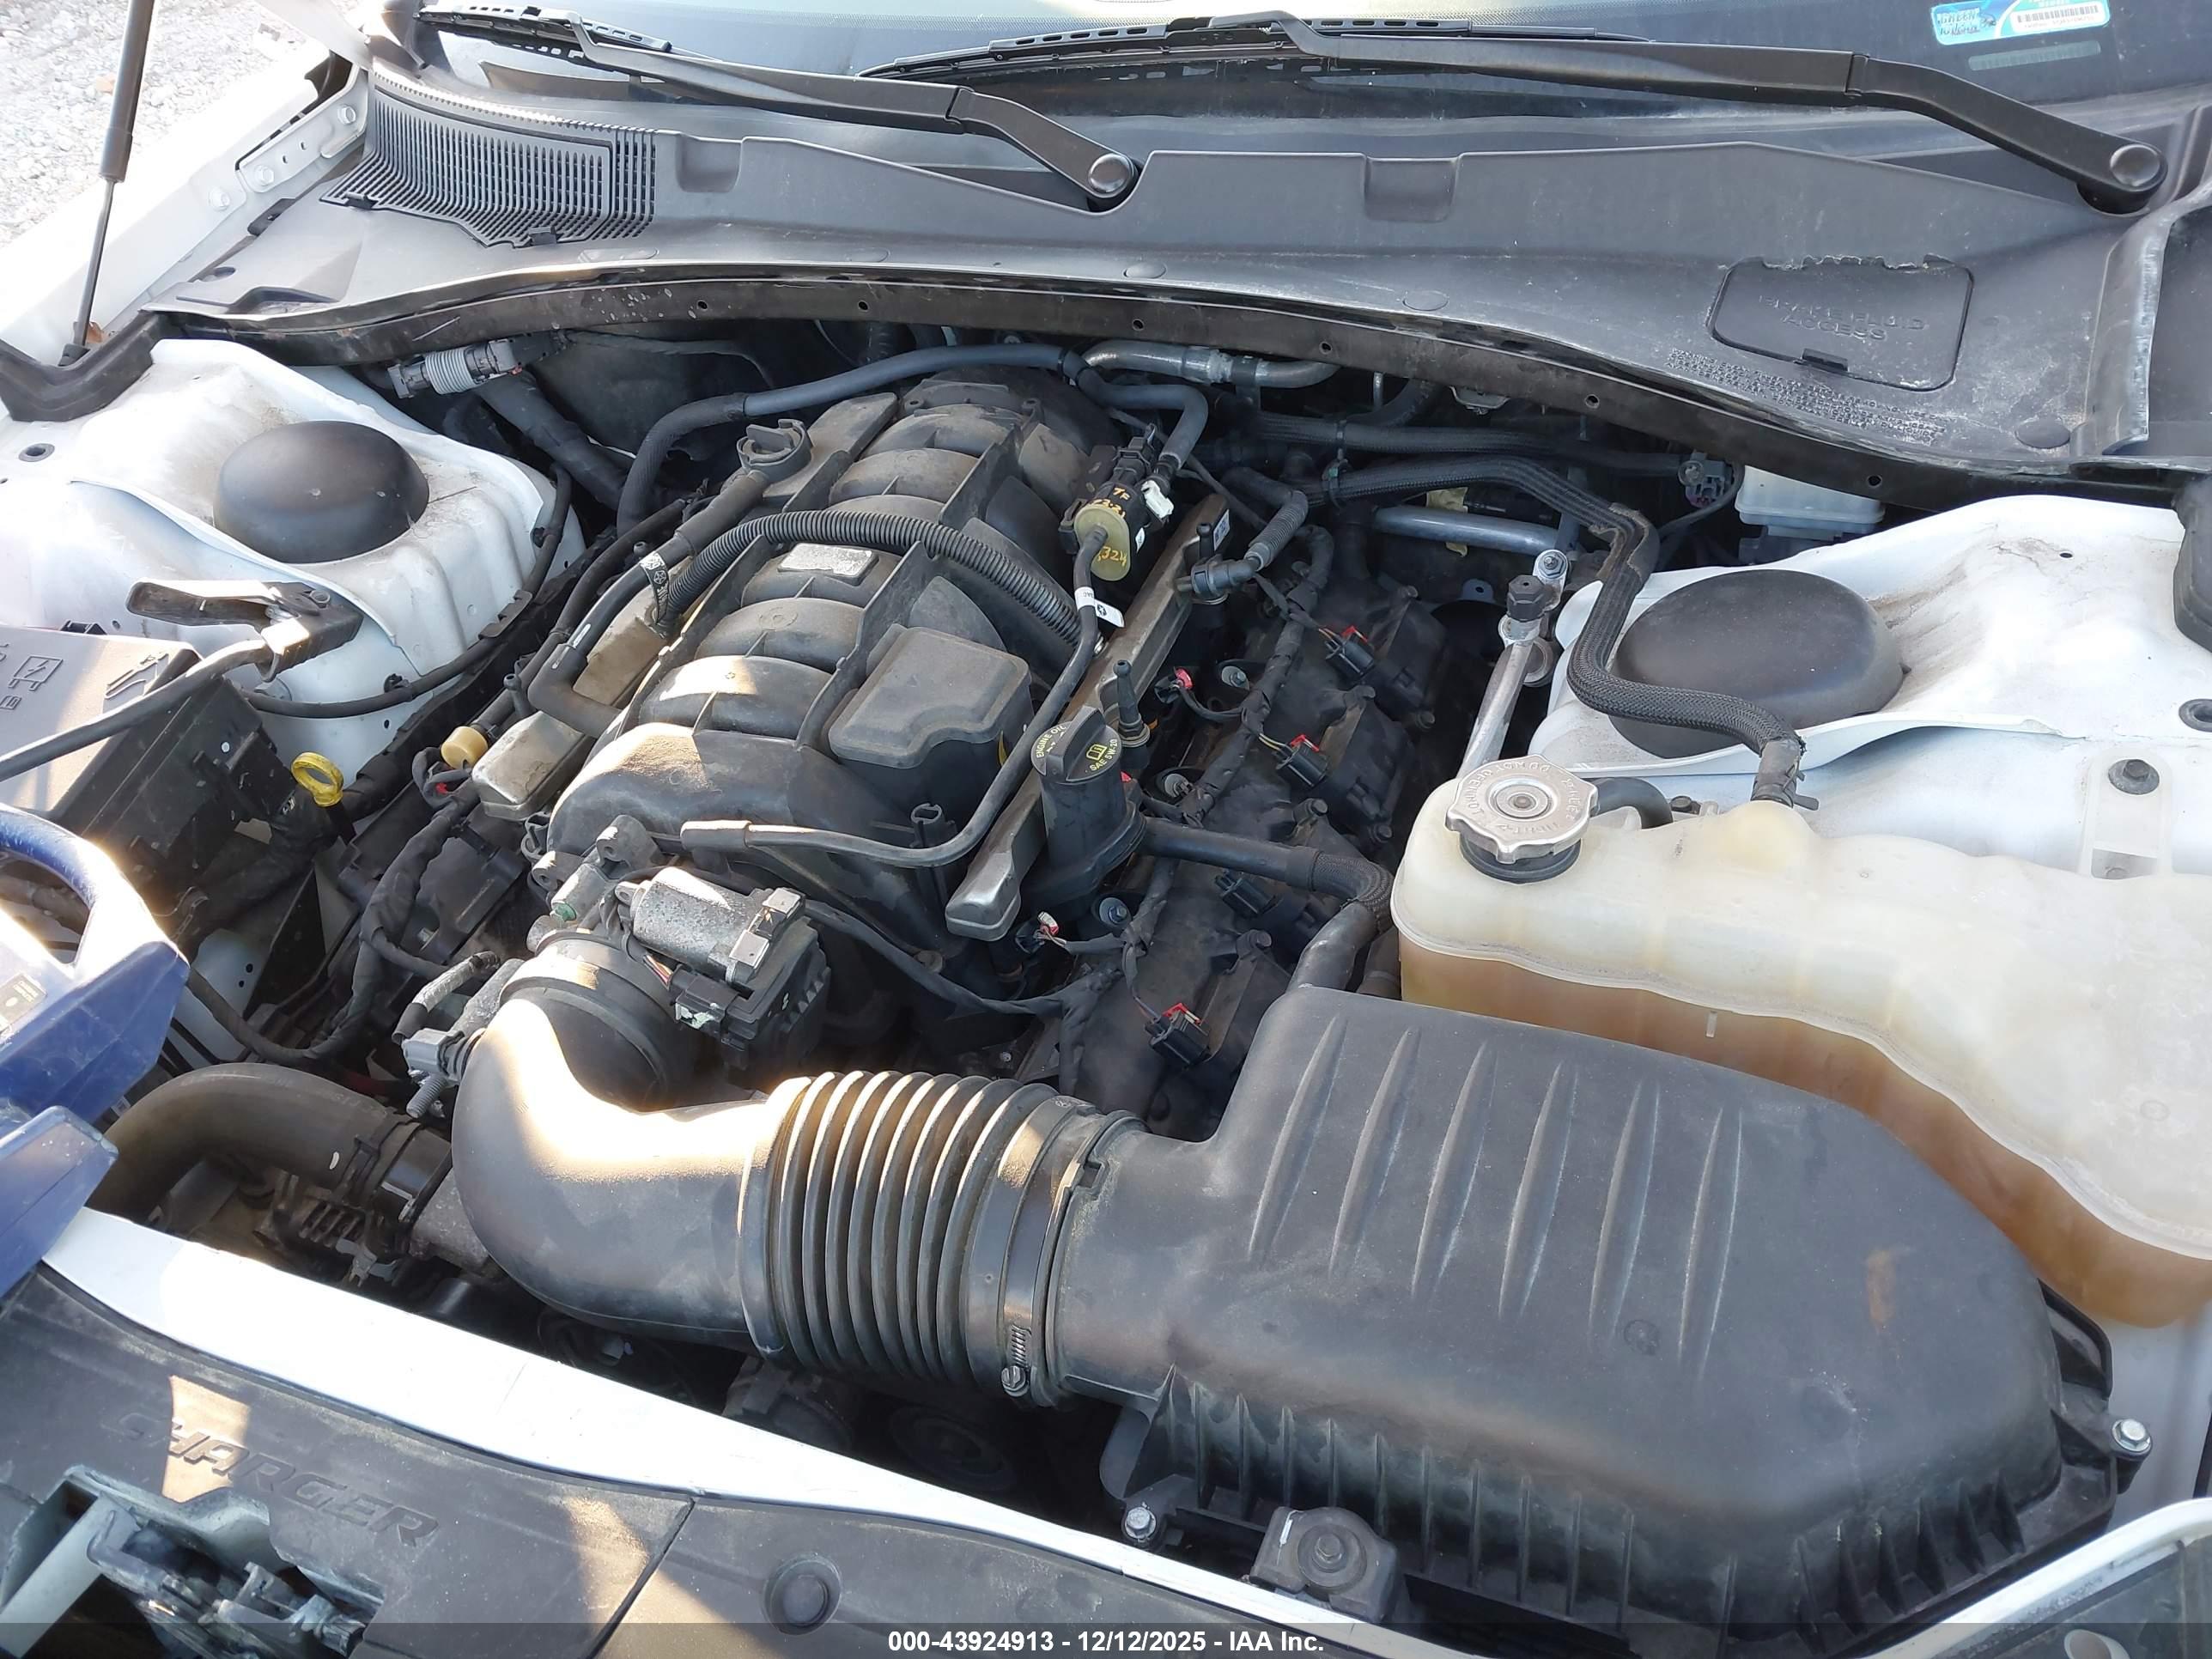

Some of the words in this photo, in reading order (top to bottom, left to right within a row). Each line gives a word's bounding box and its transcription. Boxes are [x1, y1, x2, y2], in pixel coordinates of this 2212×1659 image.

[1780, 314, 1888, 341] ACCESS
[1036, 734, 1052, 758] ENGINE
[1090, 757, 1108, 771] SAE
[1105, 738, 1118, 760] 5W-20
[117, 1412, 440, 1547] CHARGER
